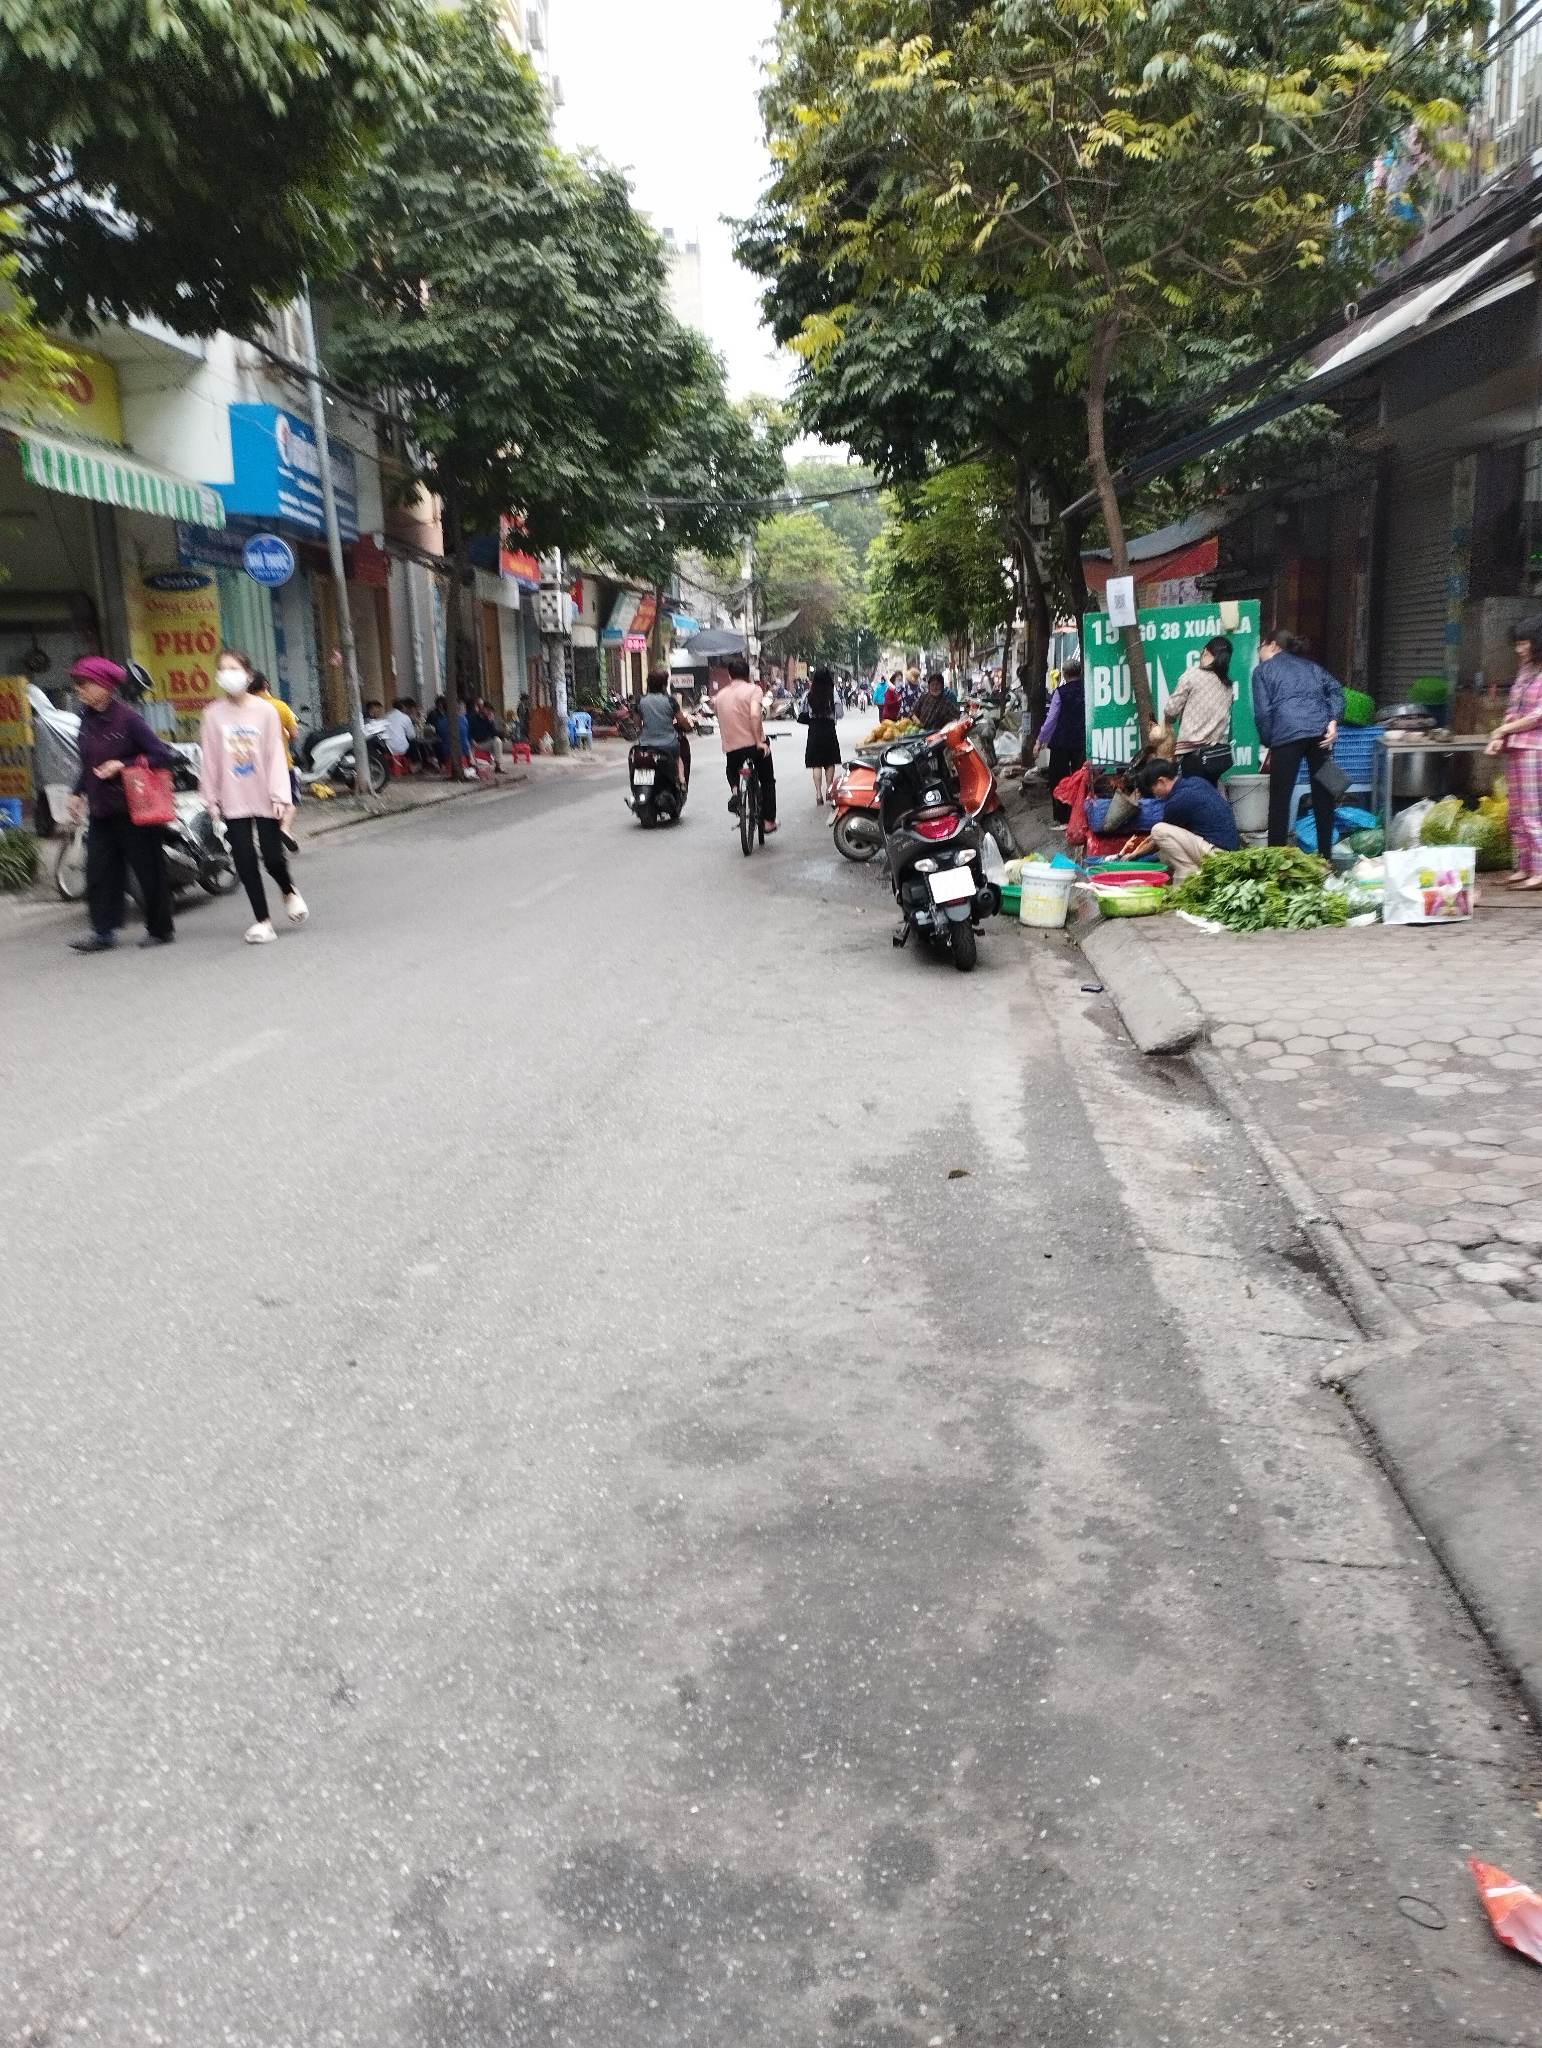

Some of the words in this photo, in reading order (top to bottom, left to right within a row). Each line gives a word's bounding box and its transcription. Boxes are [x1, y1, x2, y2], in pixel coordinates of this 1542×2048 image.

[152, 621, 216, 657] PHỞ
[1091, 620, 1120, 646] 15
[1160, 622, 1180, 640] 38
[168, 664, 210, 694] BÒ
[1092, 712, 1142, 765] MIẾ
